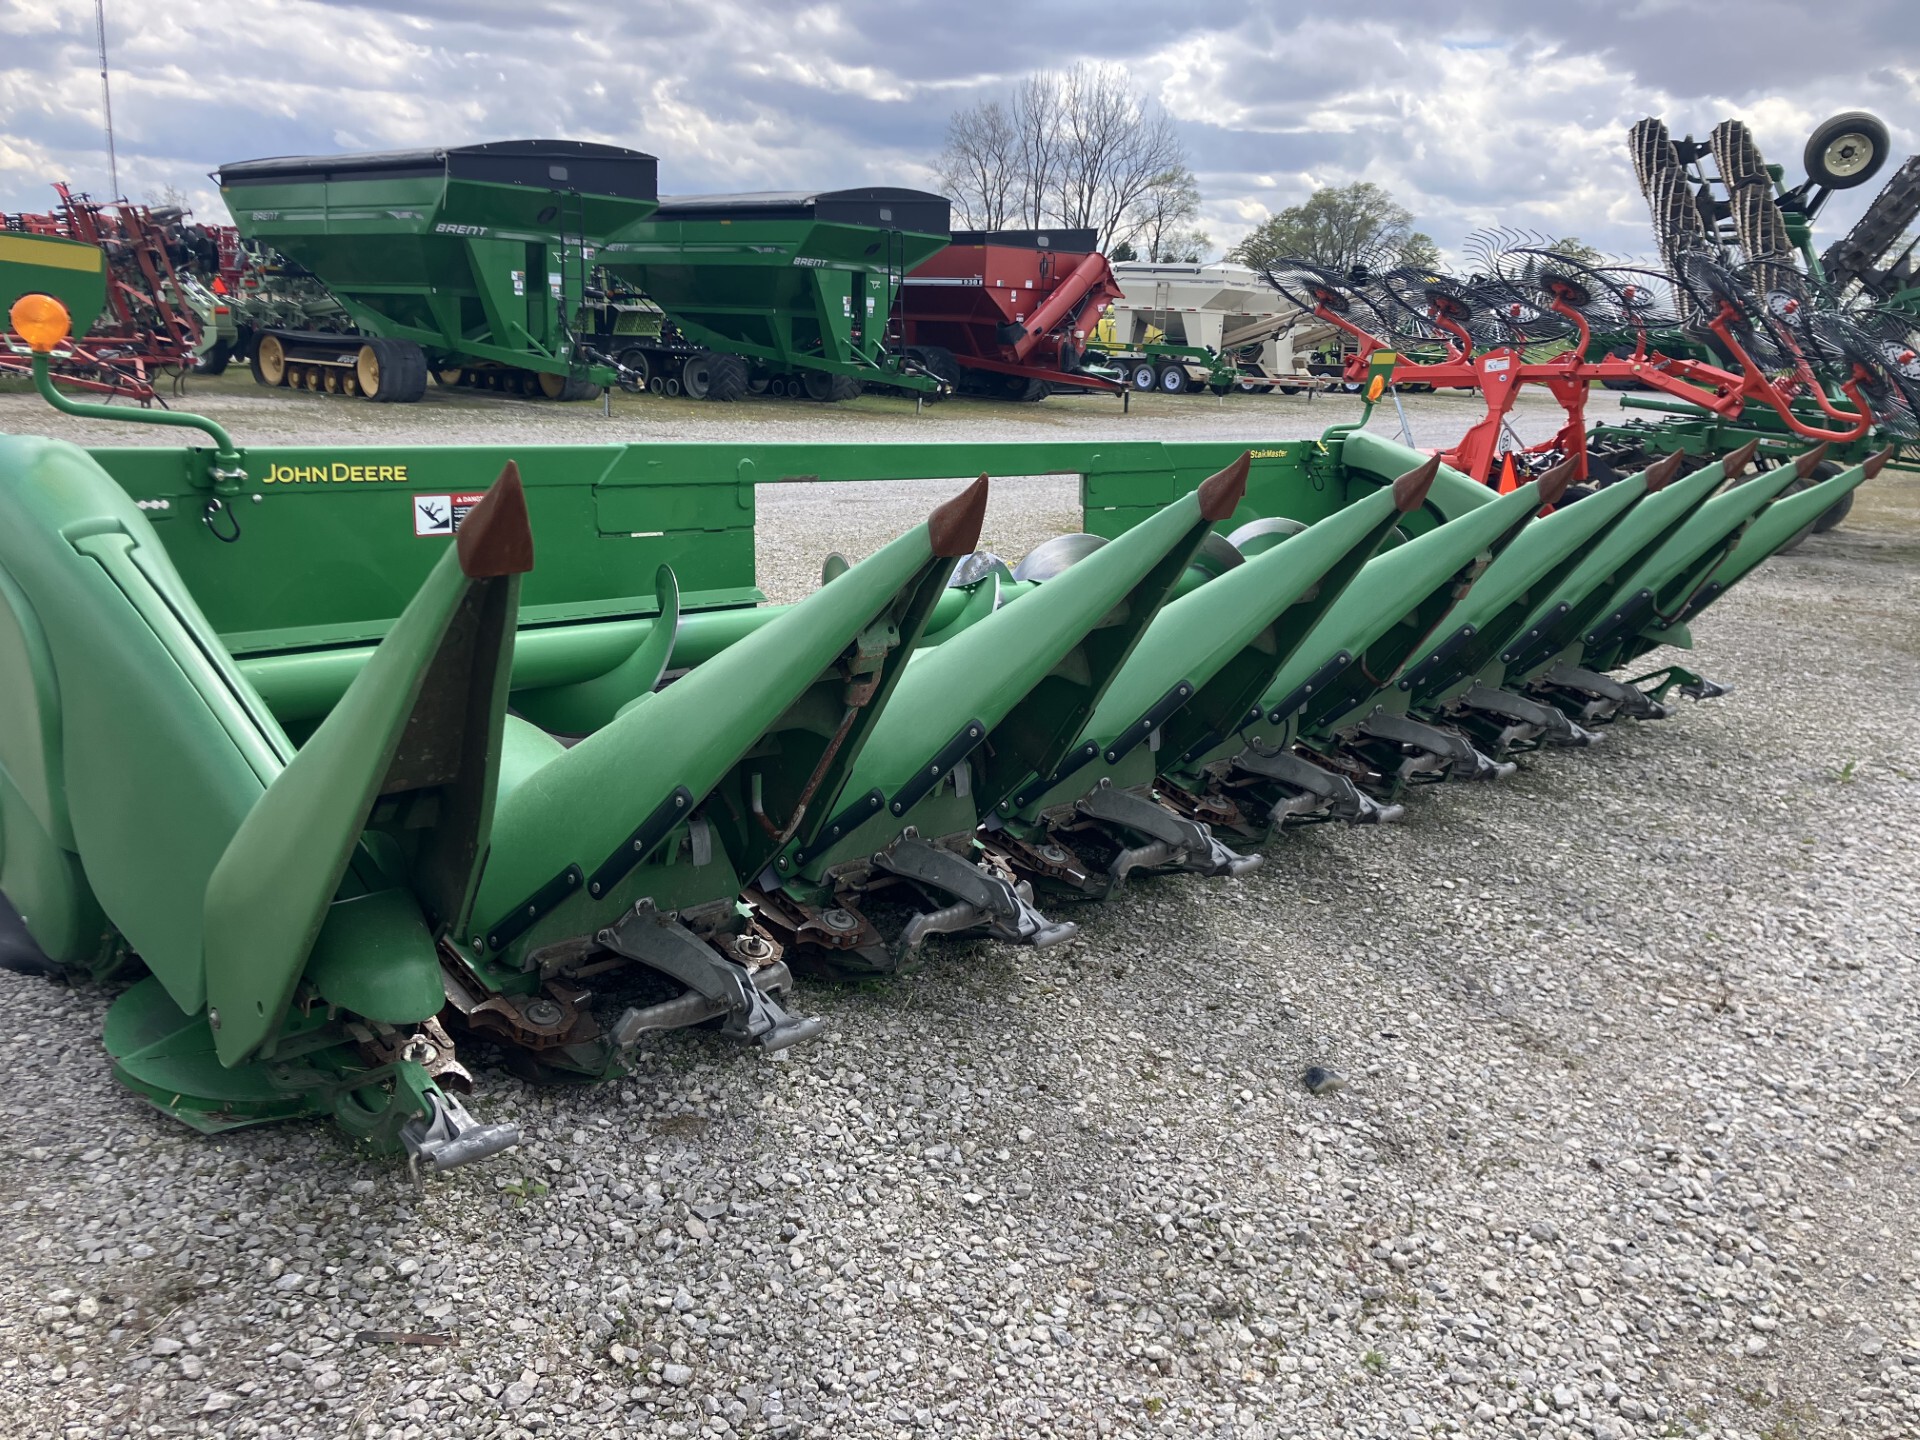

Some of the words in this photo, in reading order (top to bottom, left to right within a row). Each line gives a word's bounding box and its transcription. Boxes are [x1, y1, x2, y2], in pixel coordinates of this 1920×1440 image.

[252, 211, 280, 221] BRENT
[435, 223, 488, 236] BRENT
[793, 256, 828, 268] BRENT
